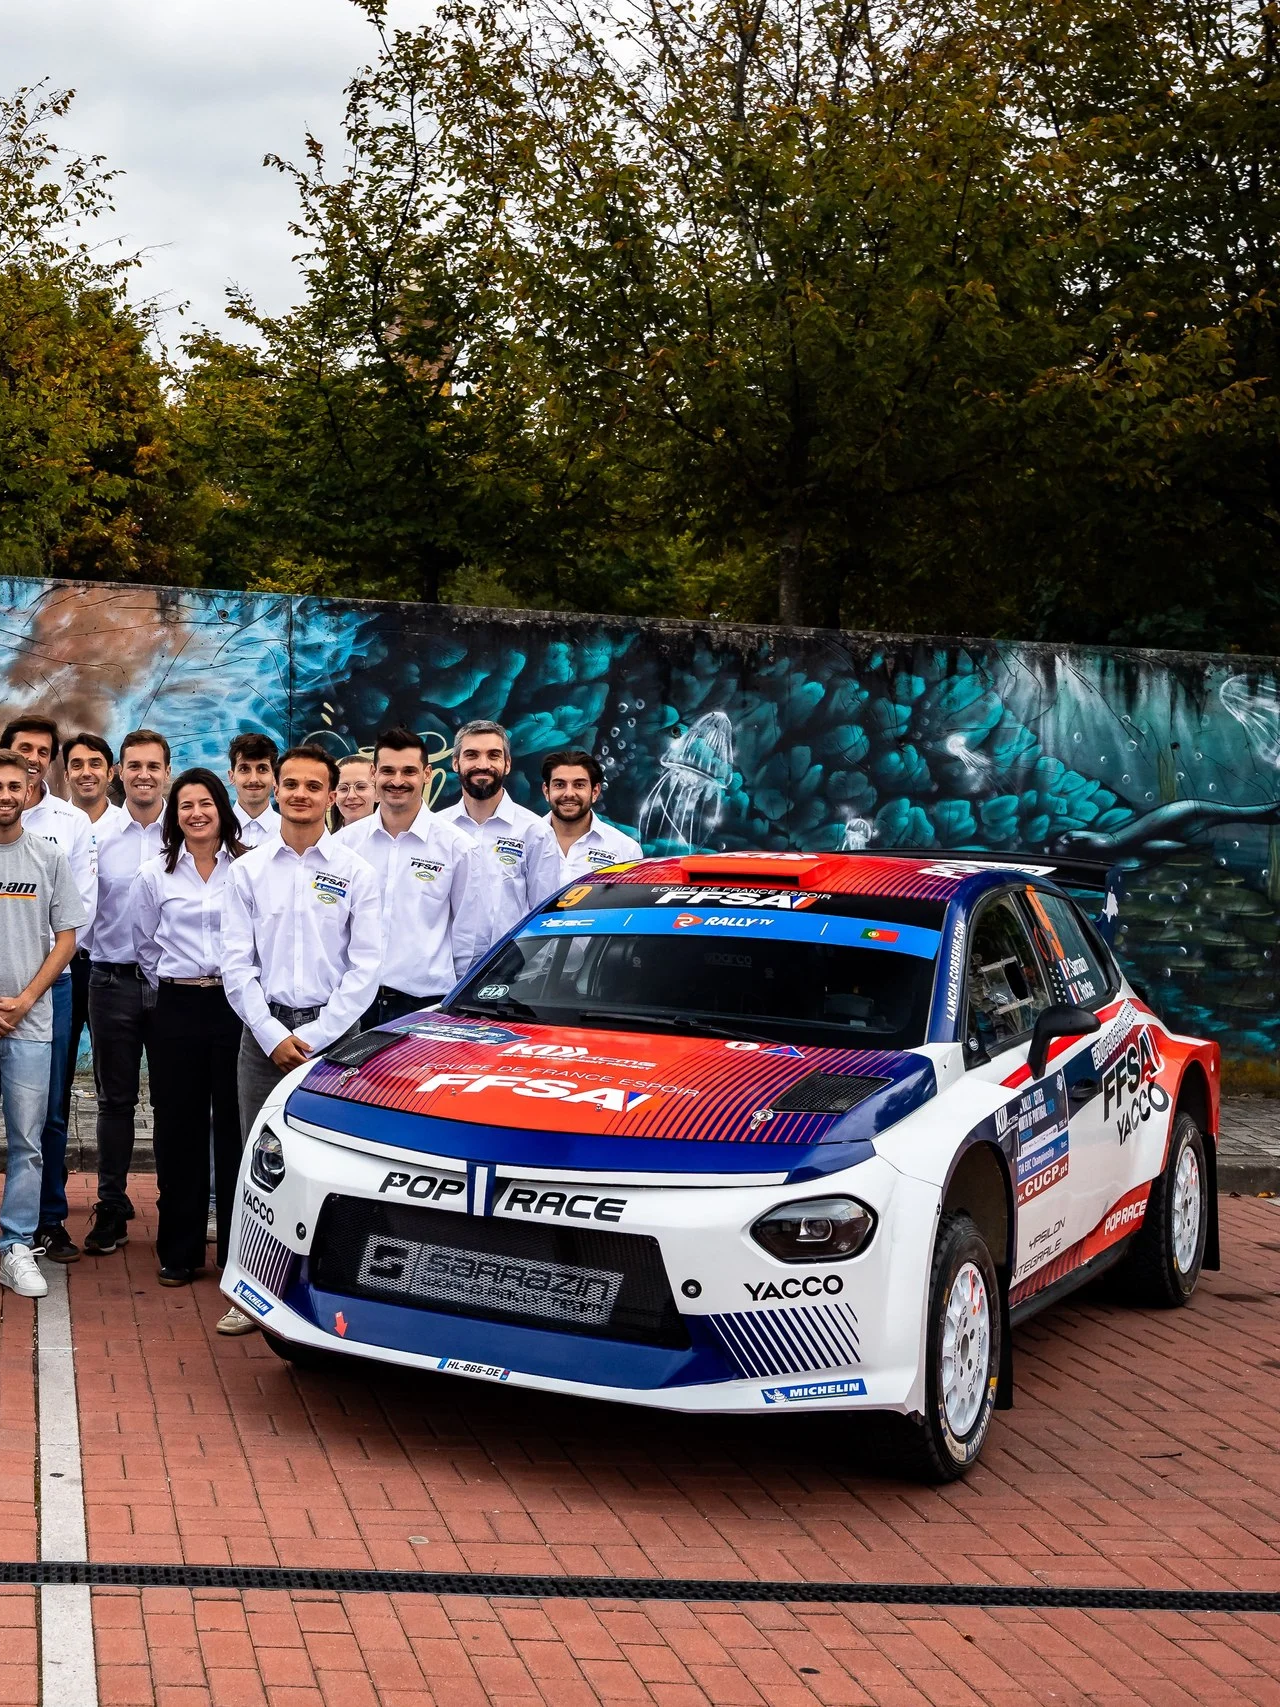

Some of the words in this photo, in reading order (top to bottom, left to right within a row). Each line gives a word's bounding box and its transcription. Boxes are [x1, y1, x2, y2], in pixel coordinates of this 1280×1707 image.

[496, 839, 522, 850] FFSA
[588, 850, 614, 861] FFSA
[410, 860, 440, 873] FFSA
[315, 875, 345, 889] FFSA
[556, 886, 593, 907] 9
[655, 891, 793, 910] FFSA
[722, 887, 778, 895] FRANCE
[778, 890, 832, 900] ESPOIR
[704, 916, 759, 927] RALLY
[759, 918, 775, 926] TV
[480, 985, 507, 998] FIA
[606, 1061, 654, 1071] PROJECT
[1102, 1027, 1158, 1123] FFSA
[422, 1062, 491, 1072] EQUIPE
[496, 1065, 526, 1074] DE
[529, 1067, 613, 1083] FRANCE
[618, 1078, 700, 1098] ESPOIR
[415, 1073, 625, 1112] FFSA
[1117, 1082, 1169, 1146] YACCO
[1031, 1146, 1055, 1168] Championship
[378, 1171, 468, 1201] POP
[503, 1188, 628, 1223] RACE
[243, 1189, 275, 1226] YACCO
[1104, 1209, 1121, 1236] POP
[1120, 1198, 1148, 1225] RACE
[743, 1274, 844, 1301] YACCO
[242, 1288, 271, 1313] MICHELIN
[446, 1360, 502, 1377] HL-865-DE
[789, 1382, 860, 1397] MICHELIN
